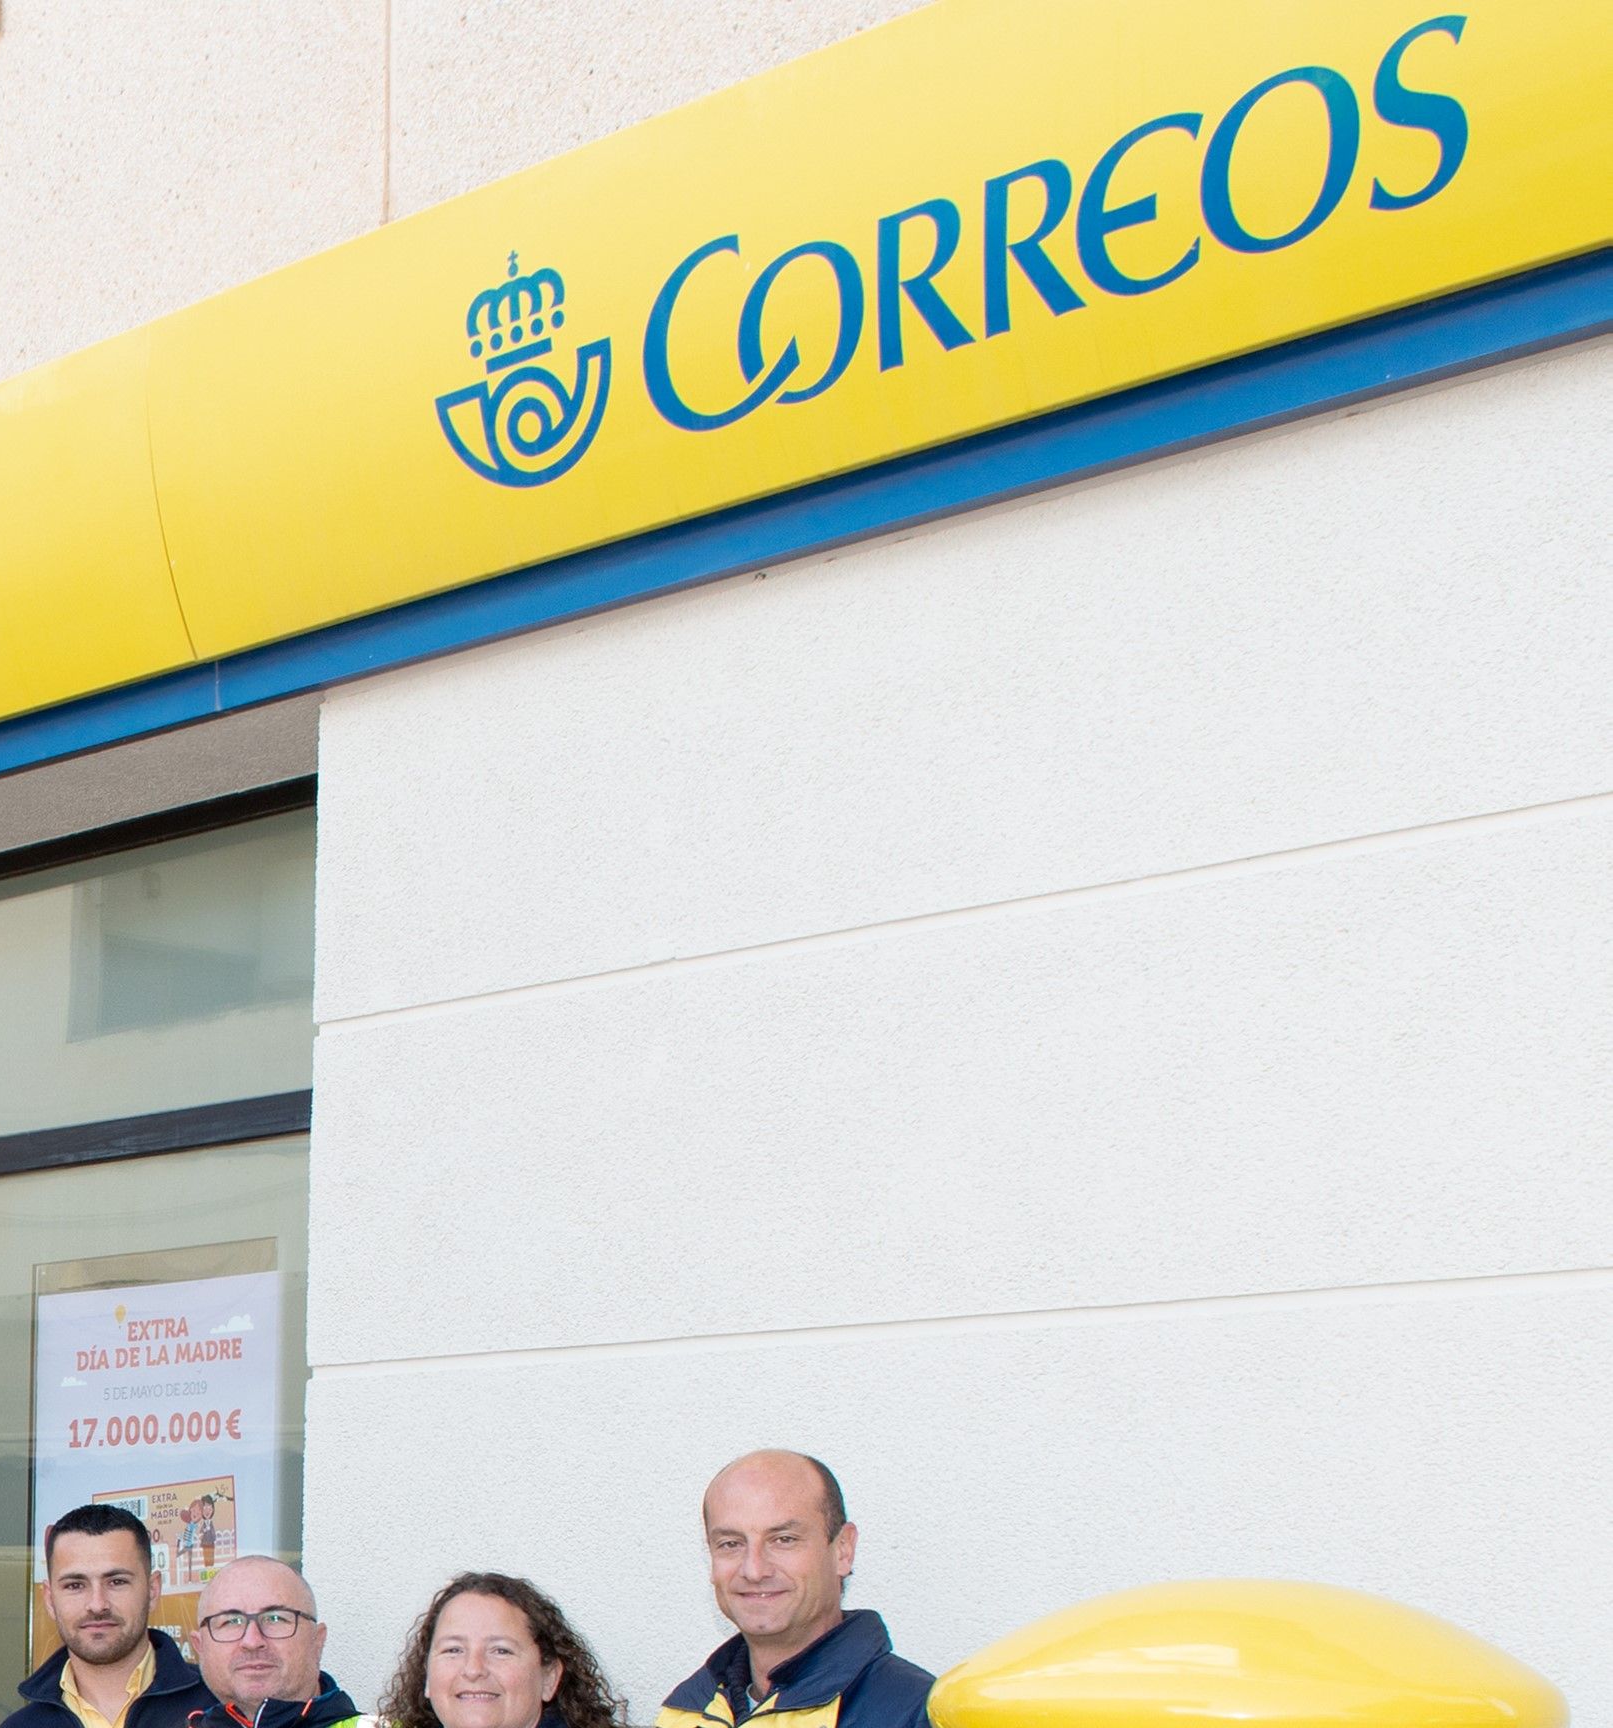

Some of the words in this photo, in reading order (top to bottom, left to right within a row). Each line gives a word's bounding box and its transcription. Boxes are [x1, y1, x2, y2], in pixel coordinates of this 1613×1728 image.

[642, 16, 1468, 432] CORREOS
[127, 1316, 189, 1342] EXTRA
[76, 1345, 109, 1371] DÍA
[115, 1346, 140, 1369] DE
[146, 1345, 169, 1367] LA
[174, 1337, 243, 1364] MADRE
[103, 1387, 111, 1401] 5
[113, 1386, 128, 1401] DE
[130, 1383, 163, 1399] MAYO
[164, 1382, 180, 1397] DE
[183, 1380, 208, 1396] 2019
[152, 1493, 178, 1504] EXTRA
[151, 1508, 179, 1520] MADRE
